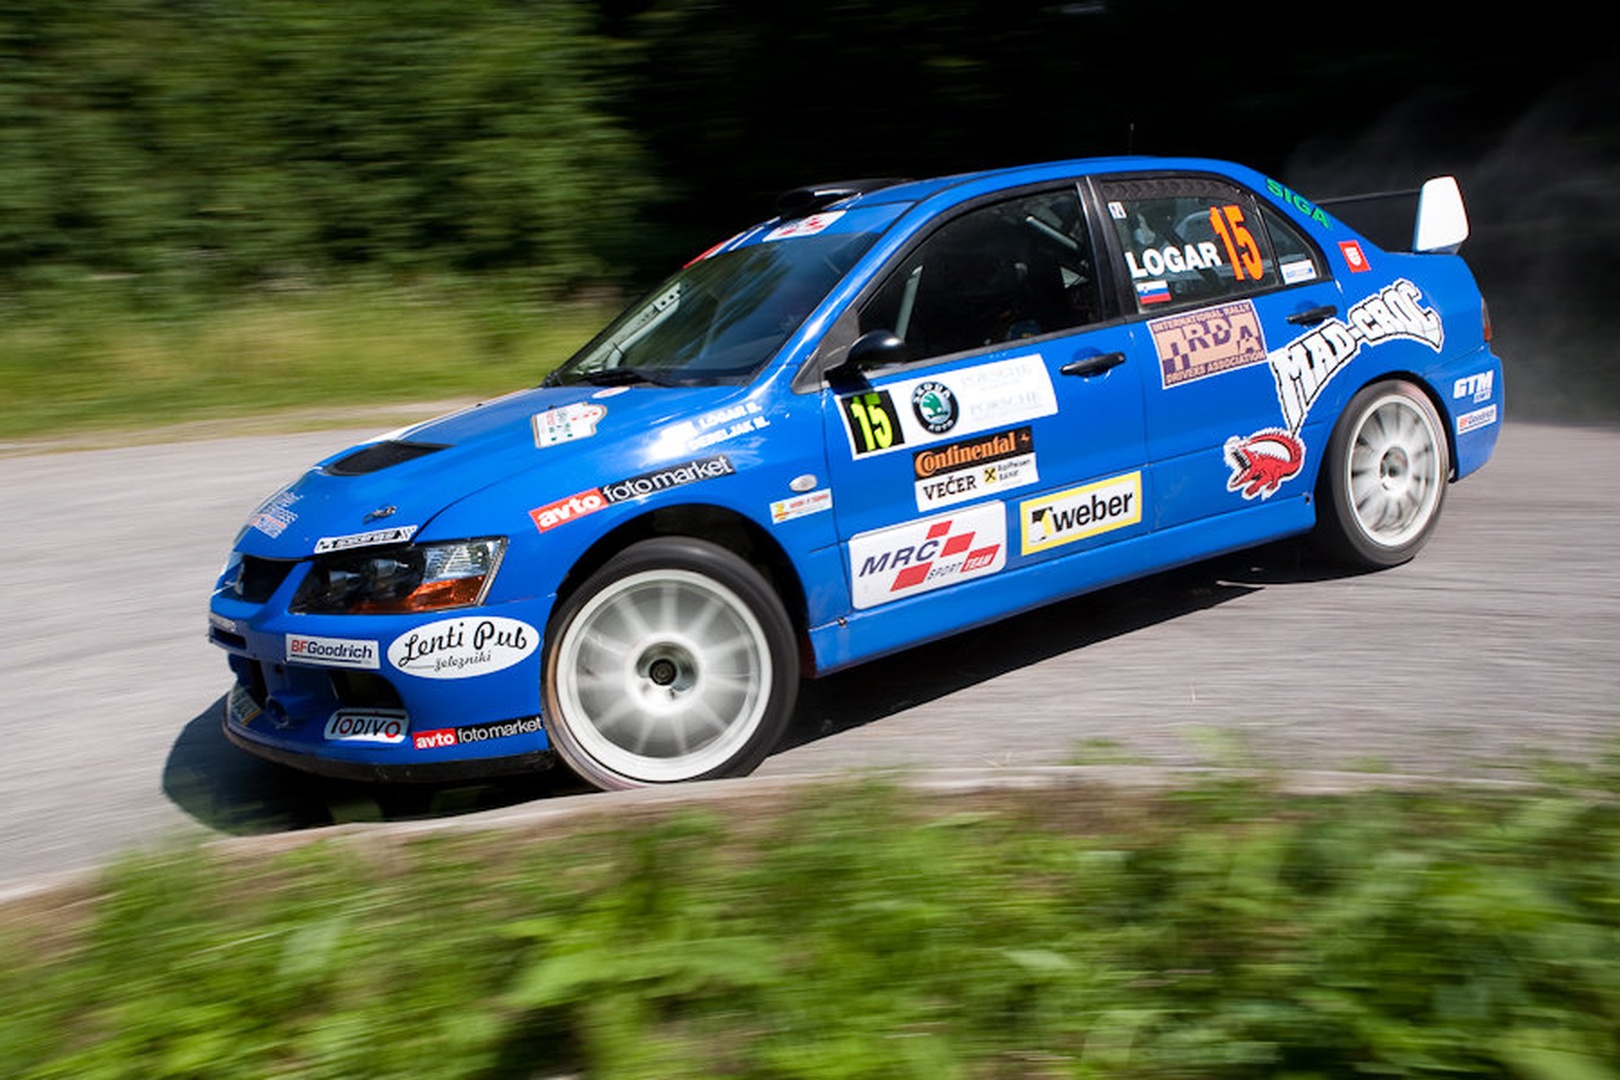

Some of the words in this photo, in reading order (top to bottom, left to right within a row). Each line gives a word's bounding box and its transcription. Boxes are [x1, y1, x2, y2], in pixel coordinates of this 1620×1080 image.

[1265, 178, 1331, 230] SIGA
[1124, 241, 1223, 279] LOGAR
[1208, 204, 1265, 282] 15
[1269, 279, 1443, 437] MAD-CROC
[1453, 369, 1494, 399] GTM
[850, 393, 894, 451] 15
[914, 431, 1017, 478] Continental
[923, 475, 977, 500] VEČER
[536, 496, 604, 529] avto
[1051, 491, 1133, 532] weber
[859, 540, 940, 577] MRC
[290, 639, 373, 659] BFGoodrich
[399, 622, 464, 667] Lenti
[473, 621, 528, 650] Pub
[414, 730, 455, 749] avto
